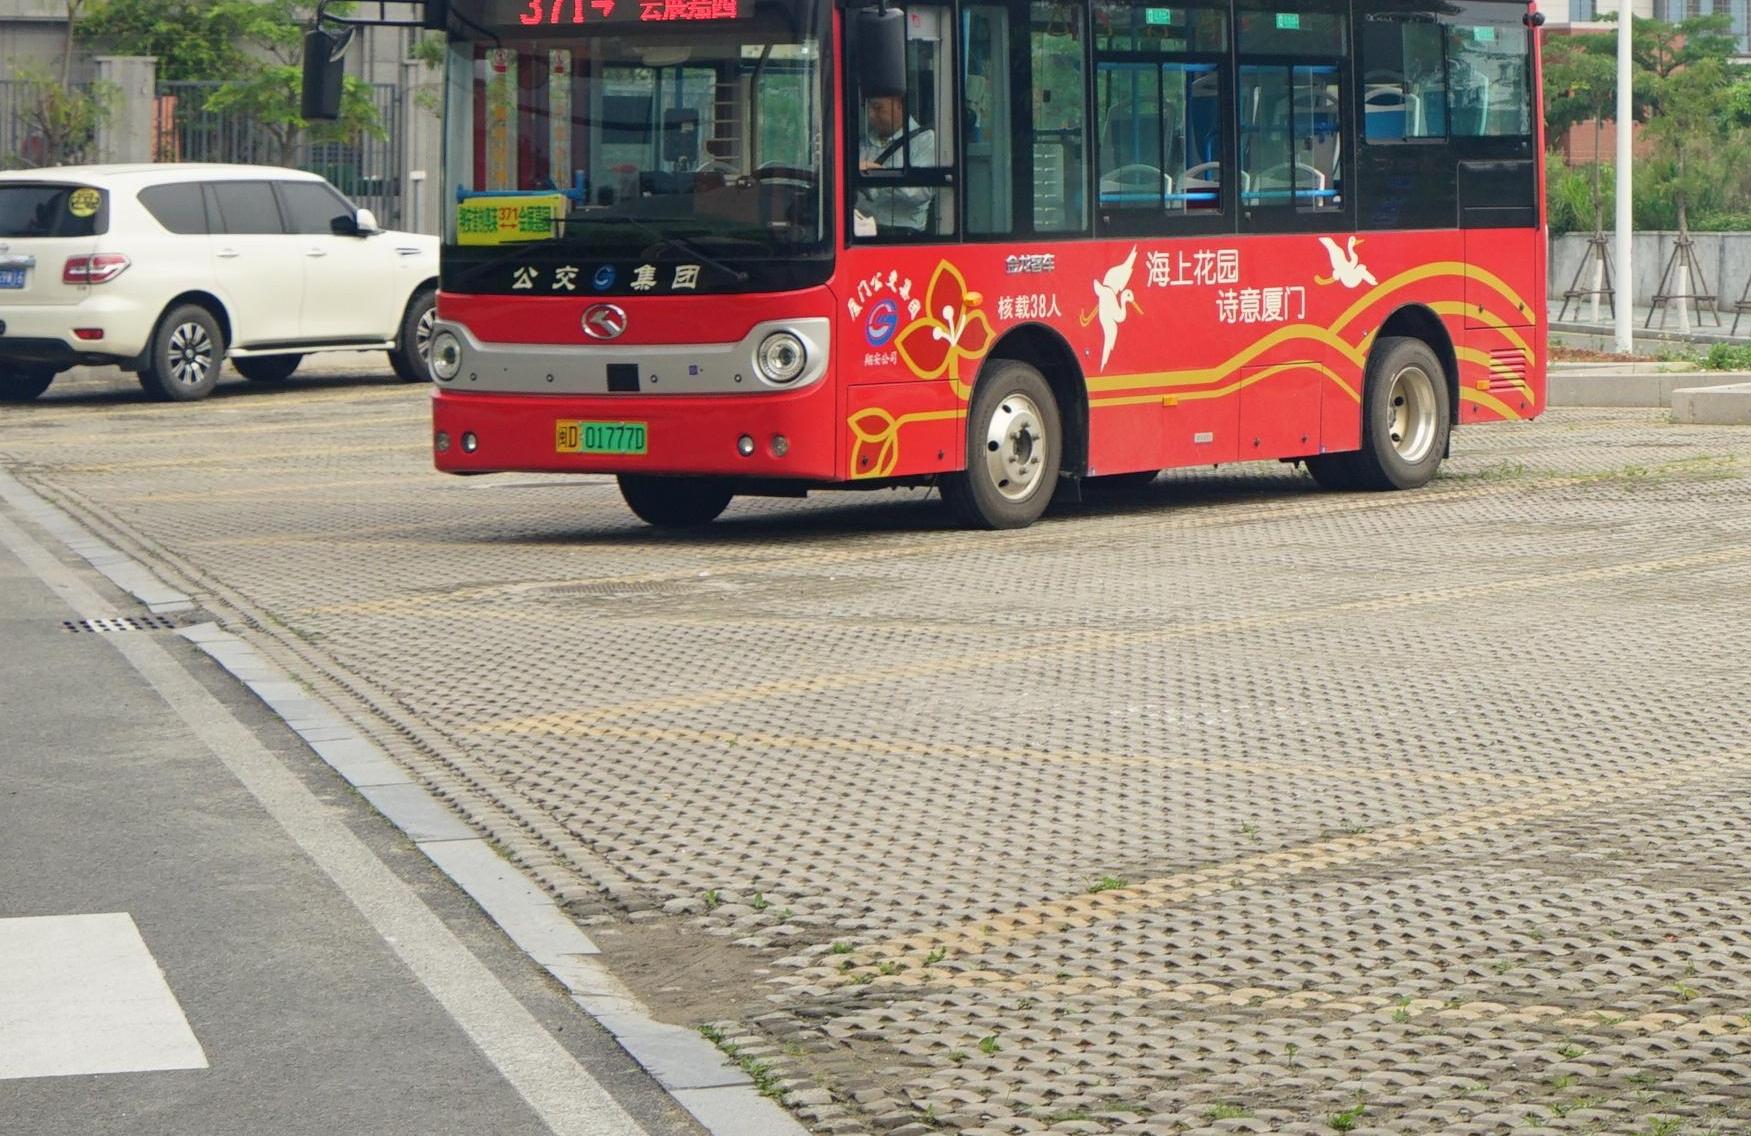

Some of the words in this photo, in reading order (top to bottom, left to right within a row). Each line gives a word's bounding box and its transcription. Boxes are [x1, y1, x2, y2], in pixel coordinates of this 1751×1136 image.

[512, 265, 579, 290] 公交
[630, 264, 701, 291] 集团
[1146, 249, 1239, 288] 海上花园
[997, 293, 1062, 320] 核载38人
[1216, 285, 1306, 324] 诗意厦门
